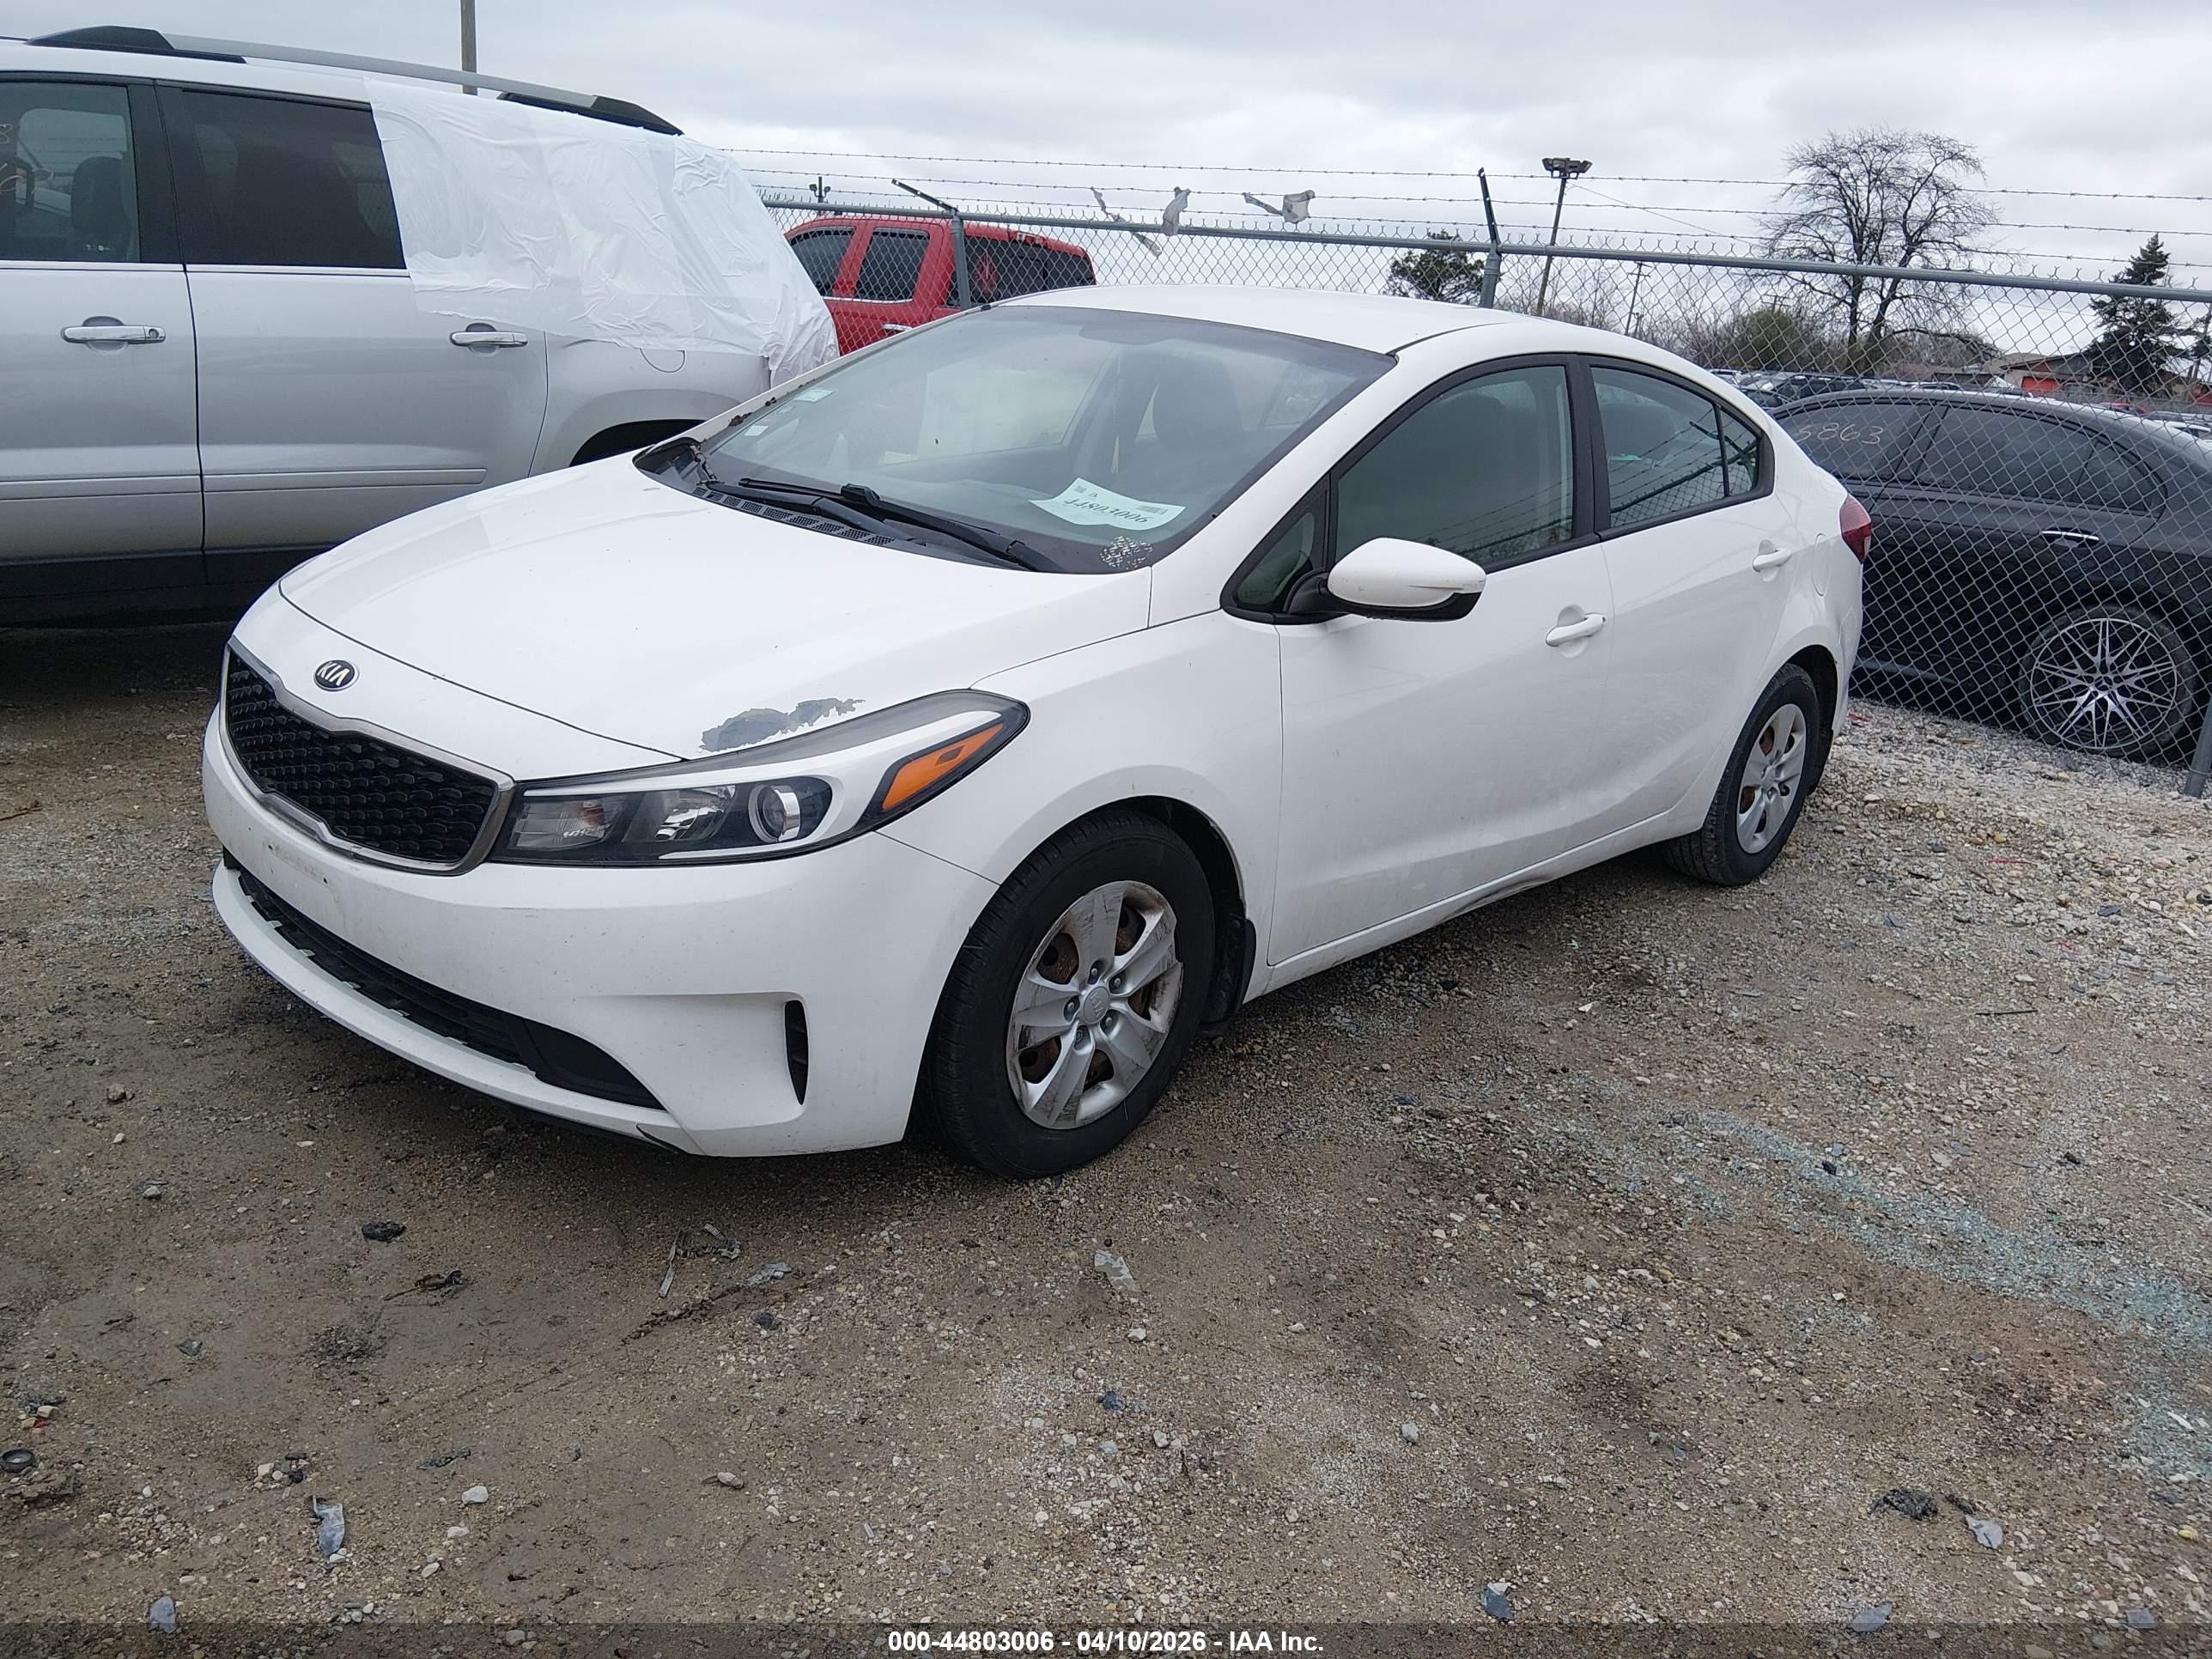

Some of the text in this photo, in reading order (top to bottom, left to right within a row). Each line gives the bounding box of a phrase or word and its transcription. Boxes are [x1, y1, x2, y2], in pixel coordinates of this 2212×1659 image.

[1795, 422, 1883, 445] 5863
[1063, 498, 1149, 523] 44803006
[316, 661, 350, 687] KIA
